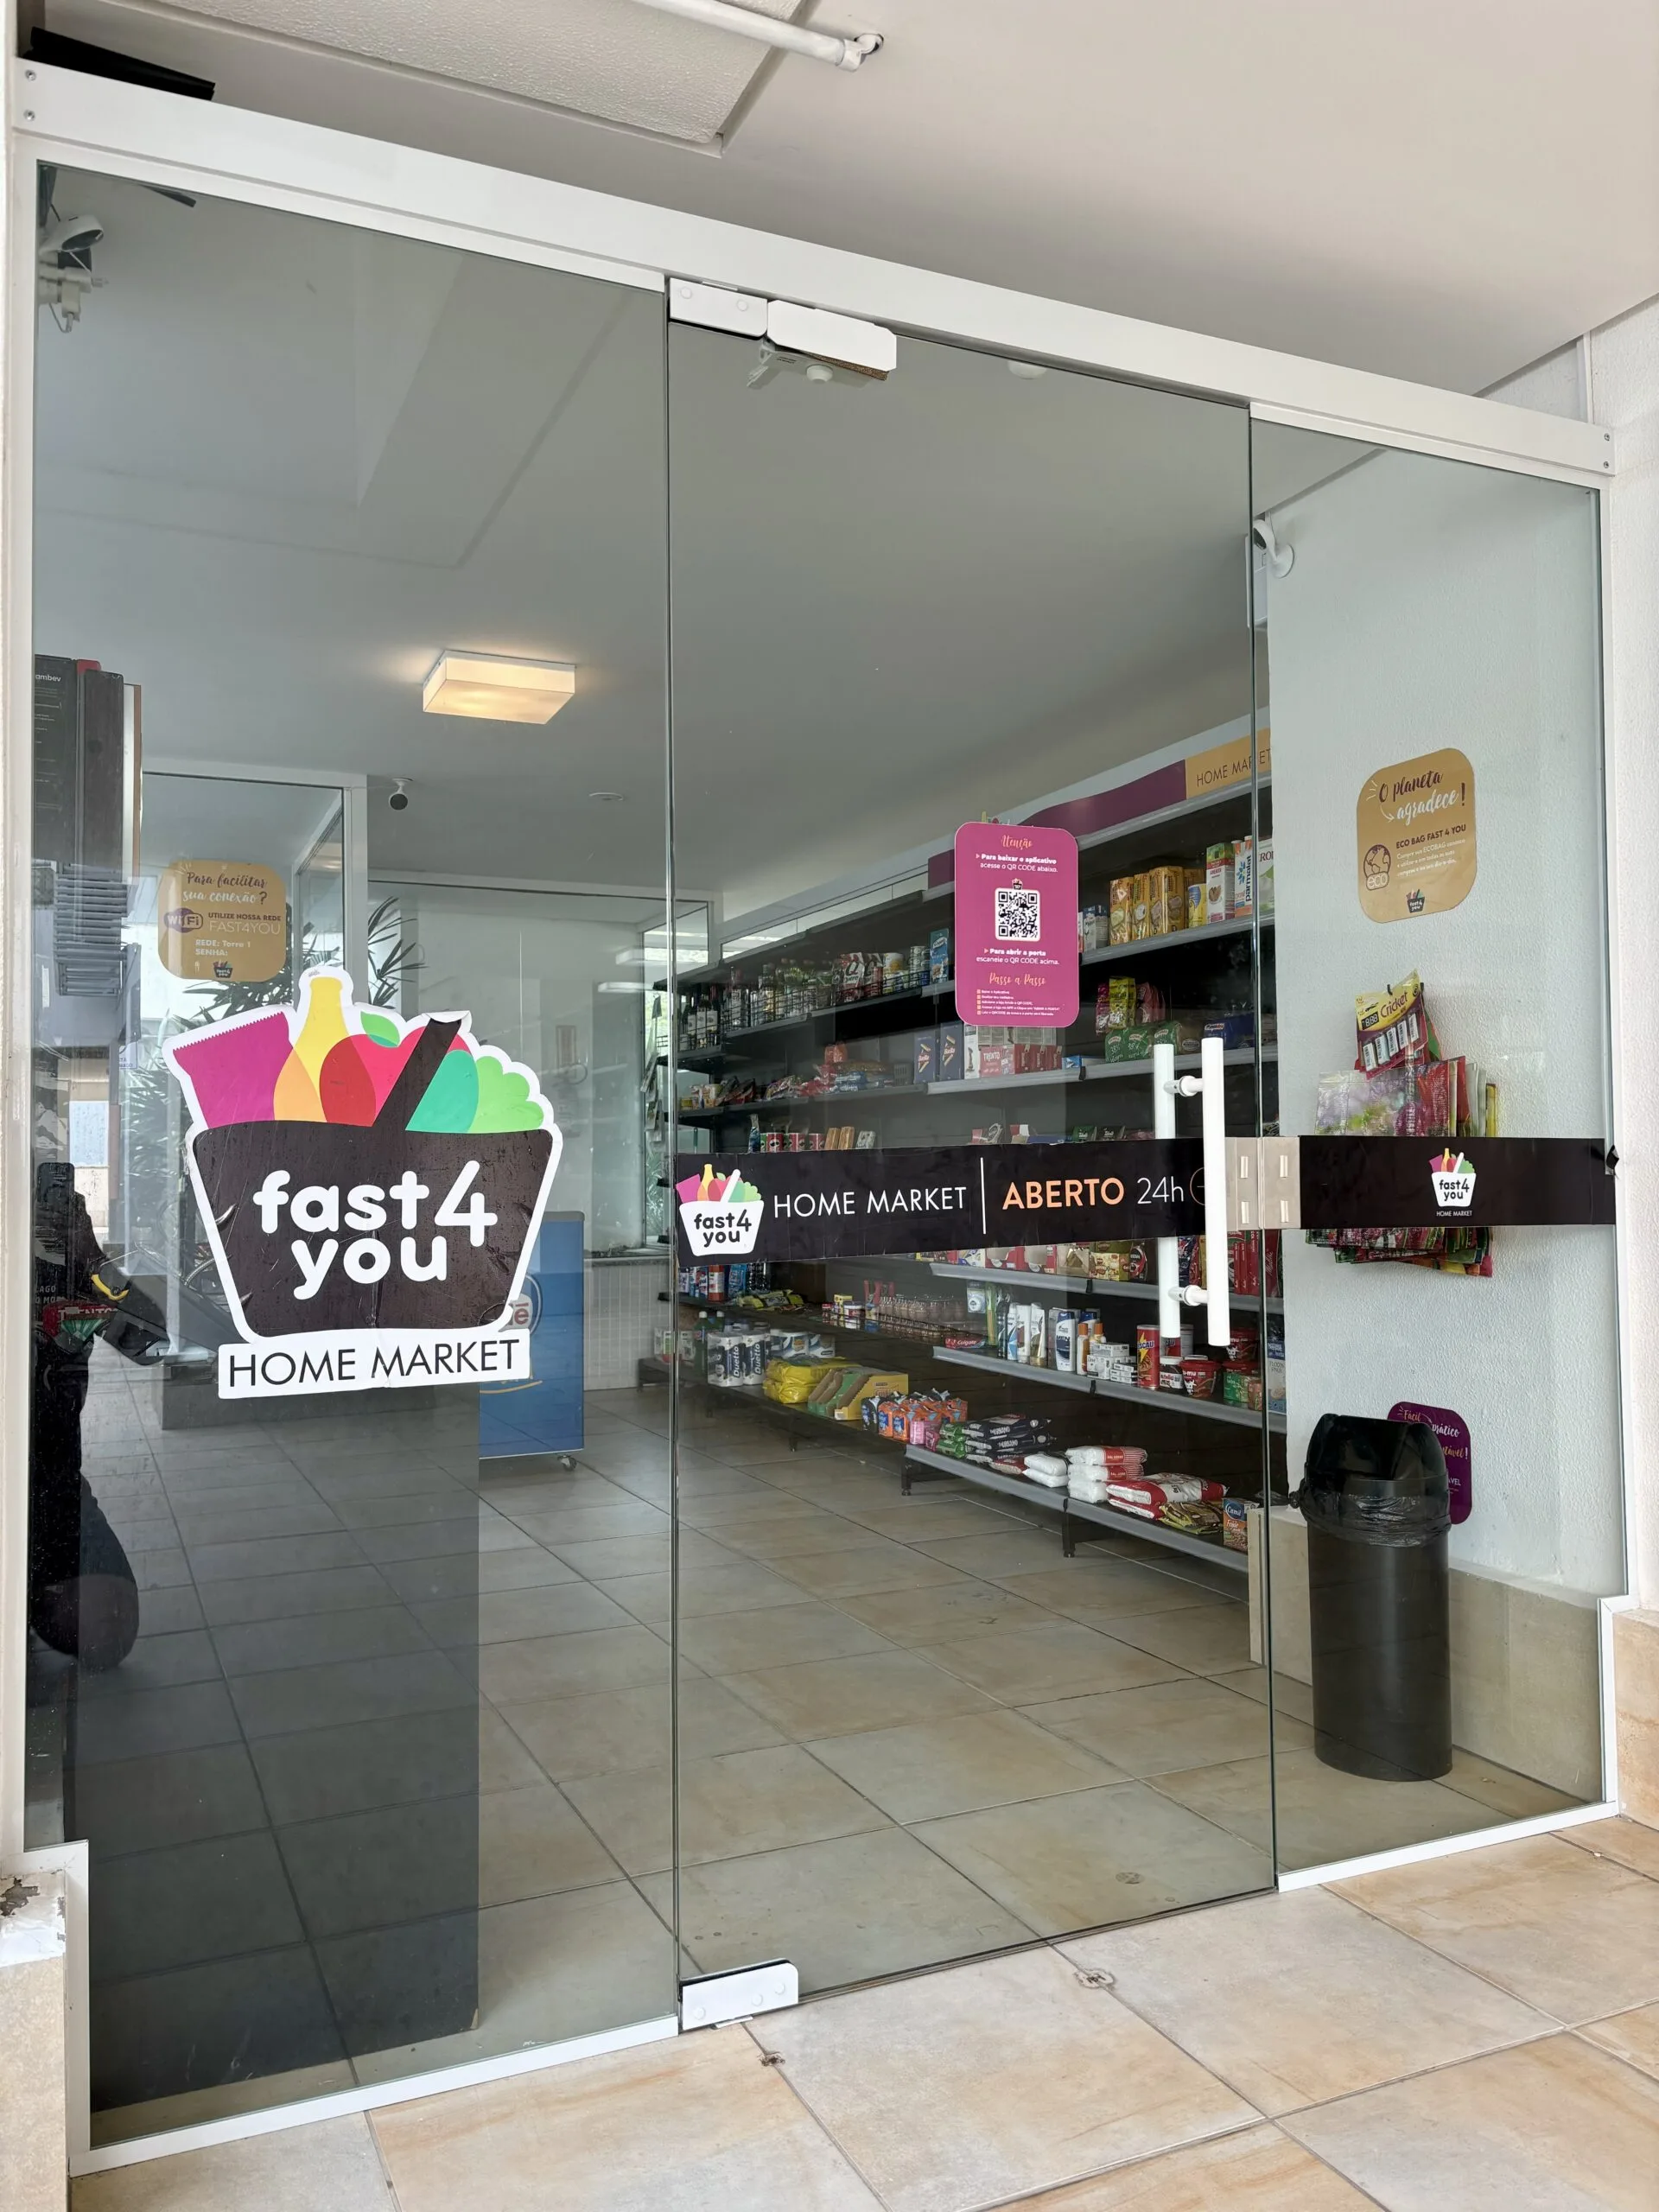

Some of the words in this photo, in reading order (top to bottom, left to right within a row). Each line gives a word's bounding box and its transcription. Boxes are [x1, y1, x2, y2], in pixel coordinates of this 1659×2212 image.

[35, 673, 61, 683] ambev
[1197, 765, 1228, 787] HOME
[1379, 783, 1389, 803] O
[1393, 770, 1444, 802] planeta
[1396, 789, 1459, 826] agradece
[1396, 839, 1410, 849] ECO
[1411, 836, 1426, 845] BAG
[1427, 830, 1444, 841] FAST
[1452, 823, 1466, 835] YOU
[997, 854, 1018, 862] baixar
[1025, 856, 1057, 865] aplicativo
[187, 871, 213, 886] Para
[217, 873, 267, 888] facilitar
[1367, 873, 1388, 888] eco
[182, 890, 207, 901] sua
[209, 891, 257, 904] conexão
[236, 912, 261, 921] NOSSA
[208, 920, 281, 935] FAST4YOU
[221, 939, 245, 948] Torre
[194, 948, 228, 957] SENHA:
[988, 972, 1012, 985] Passo
[1023, 973, 1047, 987] Passo
[1380, 990, 1408, 1018] Cricket
[1002, 1177, 1125, 1211] ABERTO
[1137, 1176, 1185, 1205] 24h
[1443, 1192, 1464, 1202] you
[773, 1191, 855, 1218] HOME
[867, 1186, 967, 1214] MARKET
[702, 1230, 741, 1249] you
[290, 1236, 448, 1300] you
[228, 1348, 356, 1388] HOME
[371, 1339, 520, 1379] MARKET
[1403, 1409, 1421, 1421] Fácil
[1227, 1505, 1242, 1516] Camil
